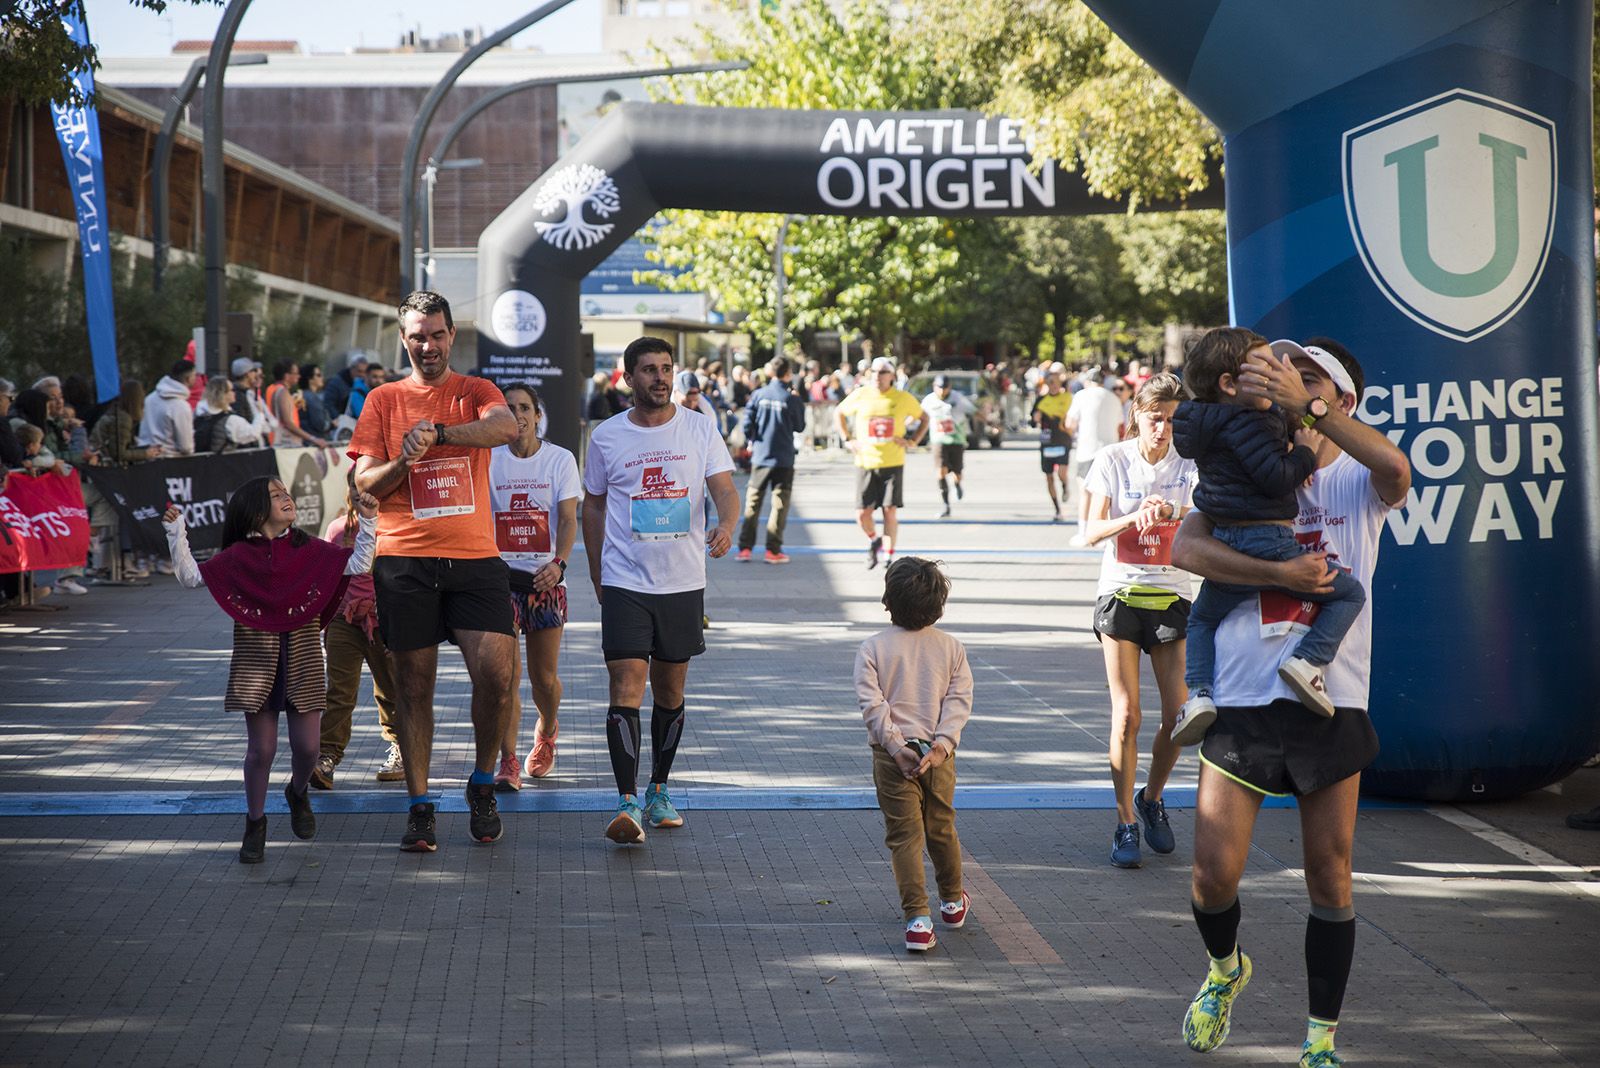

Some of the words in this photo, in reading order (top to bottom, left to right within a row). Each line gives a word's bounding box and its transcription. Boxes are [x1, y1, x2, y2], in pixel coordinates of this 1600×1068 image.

[820, 118, 1040, 154] AMETLLE
[817, 156, 1056, 209] ORIGEN
[1356, 377, 1564, 425] CHANGE
[624, 459, 643, 468] MITJA
[427, 476, 459, 490] SAMUEL
[646, 473, 668, 485] 21K
[513, 500, 533, 509] 21K
[1386, 480, 1565, 546] WAY
[510, 526, 536, 536] ANGELA
[1138, 535, 1160, 545] ANNA
